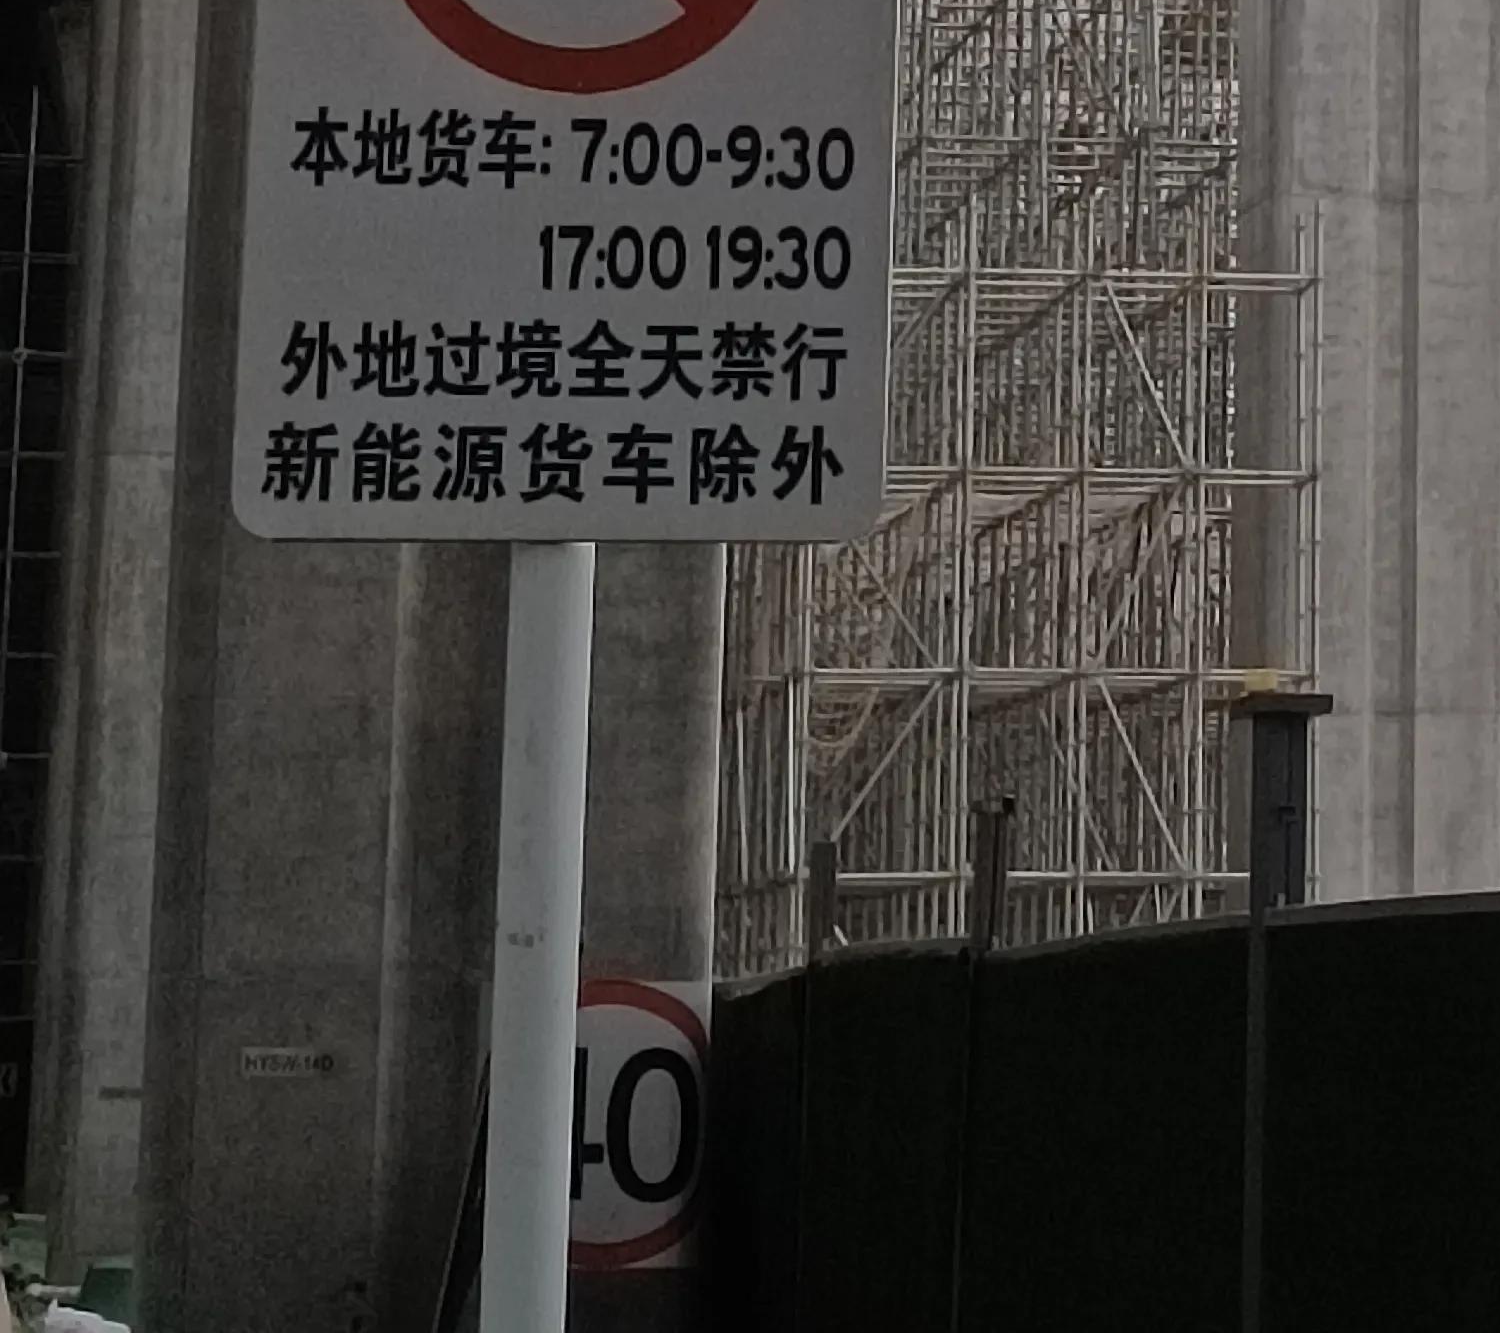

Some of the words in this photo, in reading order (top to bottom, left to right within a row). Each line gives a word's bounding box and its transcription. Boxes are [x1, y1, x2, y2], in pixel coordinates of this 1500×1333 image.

[539, 223, 688, 291] 17:00
[705, 223, 851, 291] 19:30
[280, 317, 848, 402] 外地过境全天禁行
[261, 419, 845, 506] 新能源货车除外
